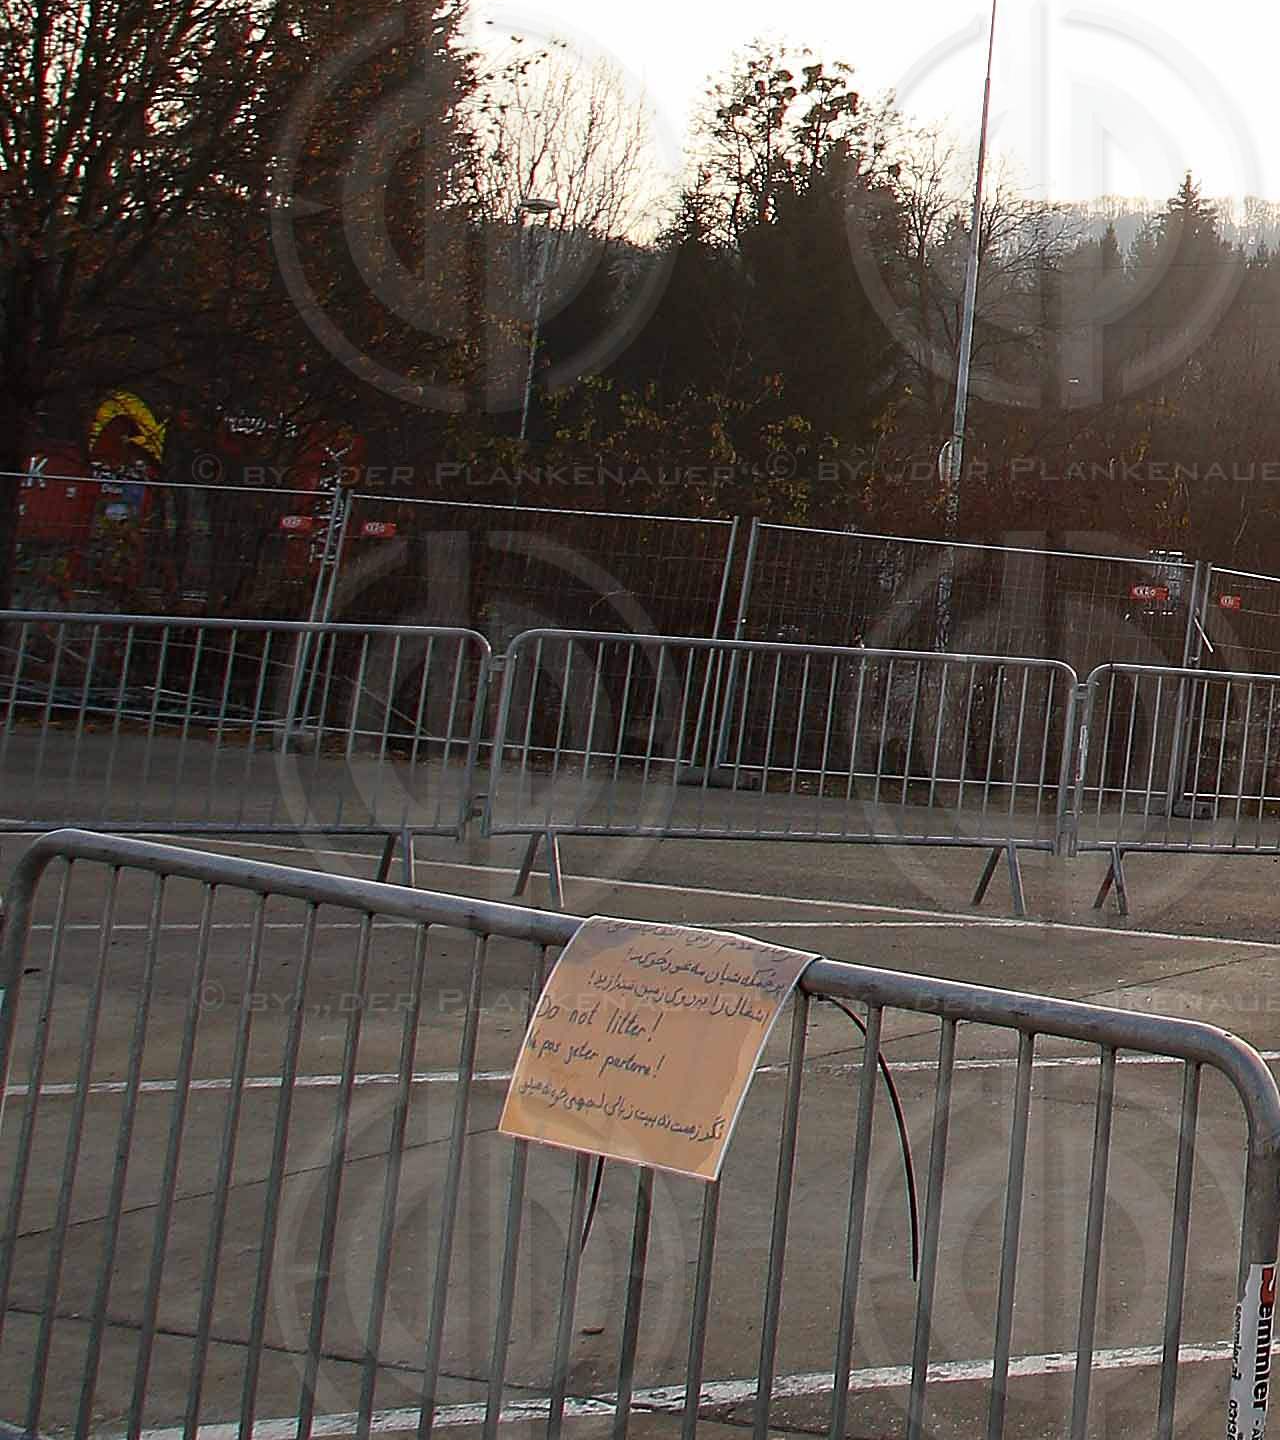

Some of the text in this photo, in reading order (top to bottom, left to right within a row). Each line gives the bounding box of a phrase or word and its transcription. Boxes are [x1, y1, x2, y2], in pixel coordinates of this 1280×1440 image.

[536, 995, 664, 1042] Do not litter!
[539, 1038, 560, 1060] pas
